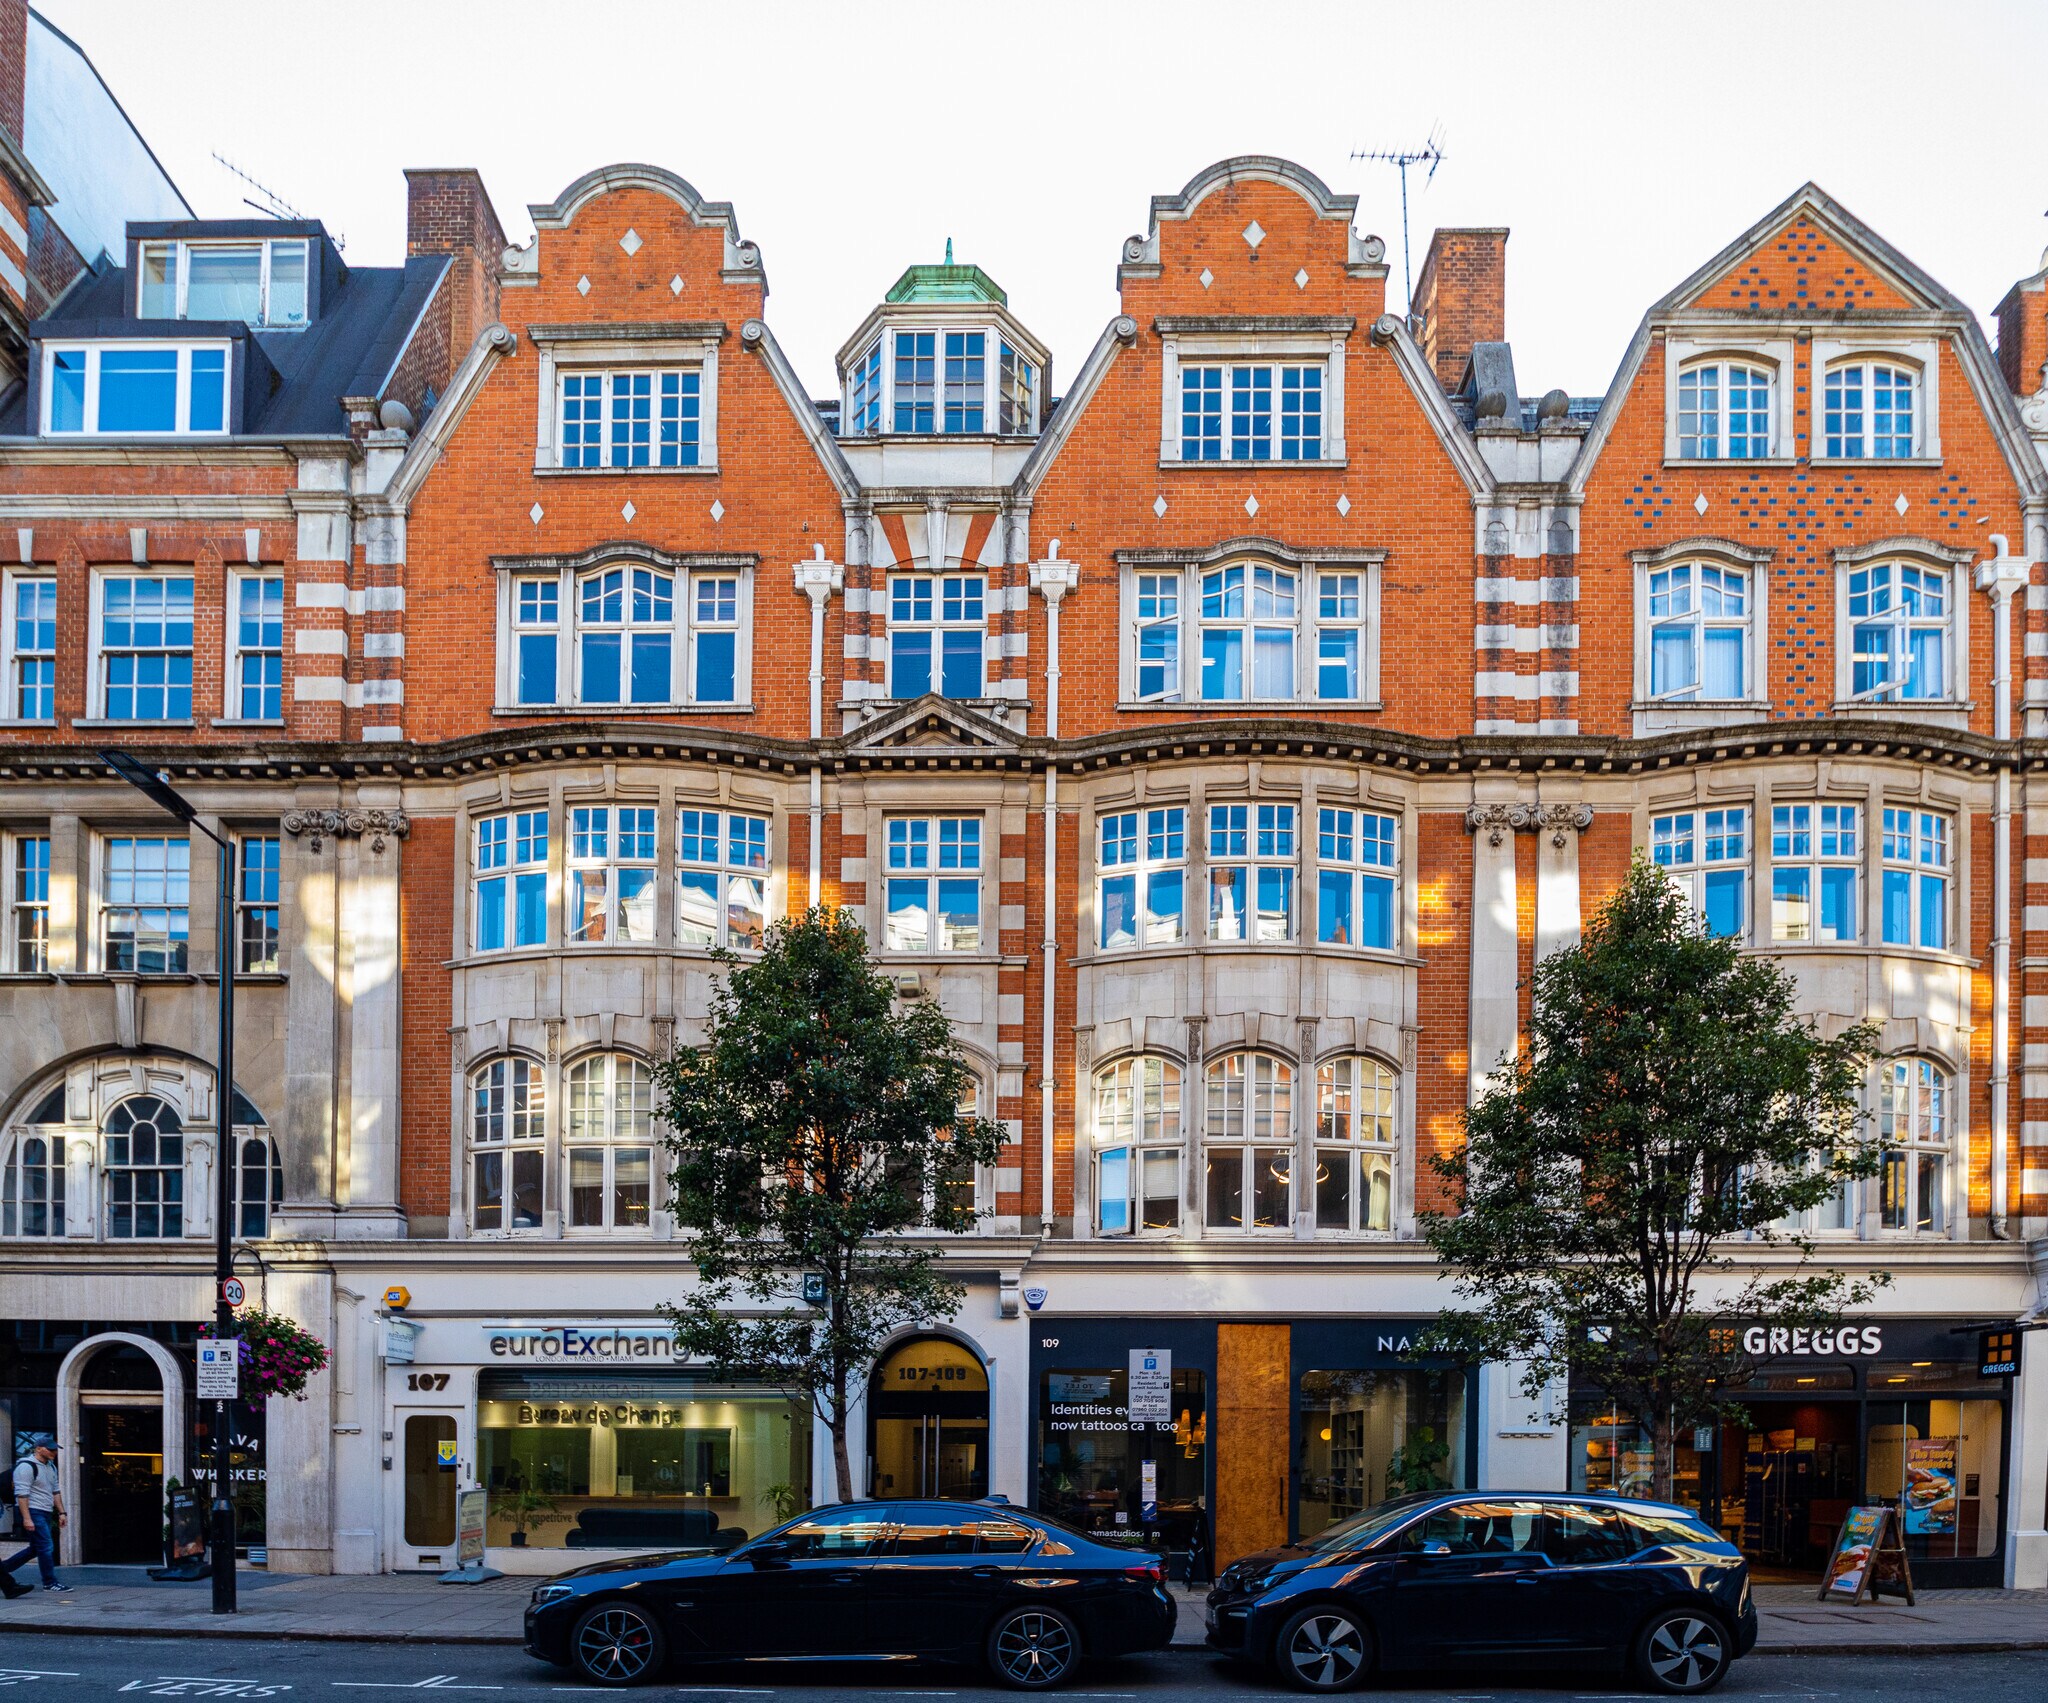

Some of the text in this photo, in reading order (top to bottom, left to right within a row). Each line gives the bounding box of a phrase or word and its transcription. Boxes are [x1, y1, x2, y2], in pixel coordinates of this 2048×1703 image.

[226, 1285, 243, 1299] 20
[1042, 1338, 1060, 1348] 109
[1743, 1326, 1882, 1355] GREGGS
[899, 1367, 966, 1380] 107-109
[1982, 1362, 2015, 1374] GREGGS
[408, 1373, 450, 1391] 107
[1051, 1404, 1112, 1415] Identities
[518, 1406, 683, 1427] Bureau de Change
[1051, 1420, 1178, 1431] now tattoos ca too
[1910, 1448, 1955, 1460] The tasty
[192, 1468, 267, 1480] WHSKER
[1087, 1529, 1160, 1538] amastudios.m
[117, 1680, 293, 1698] VEHS
